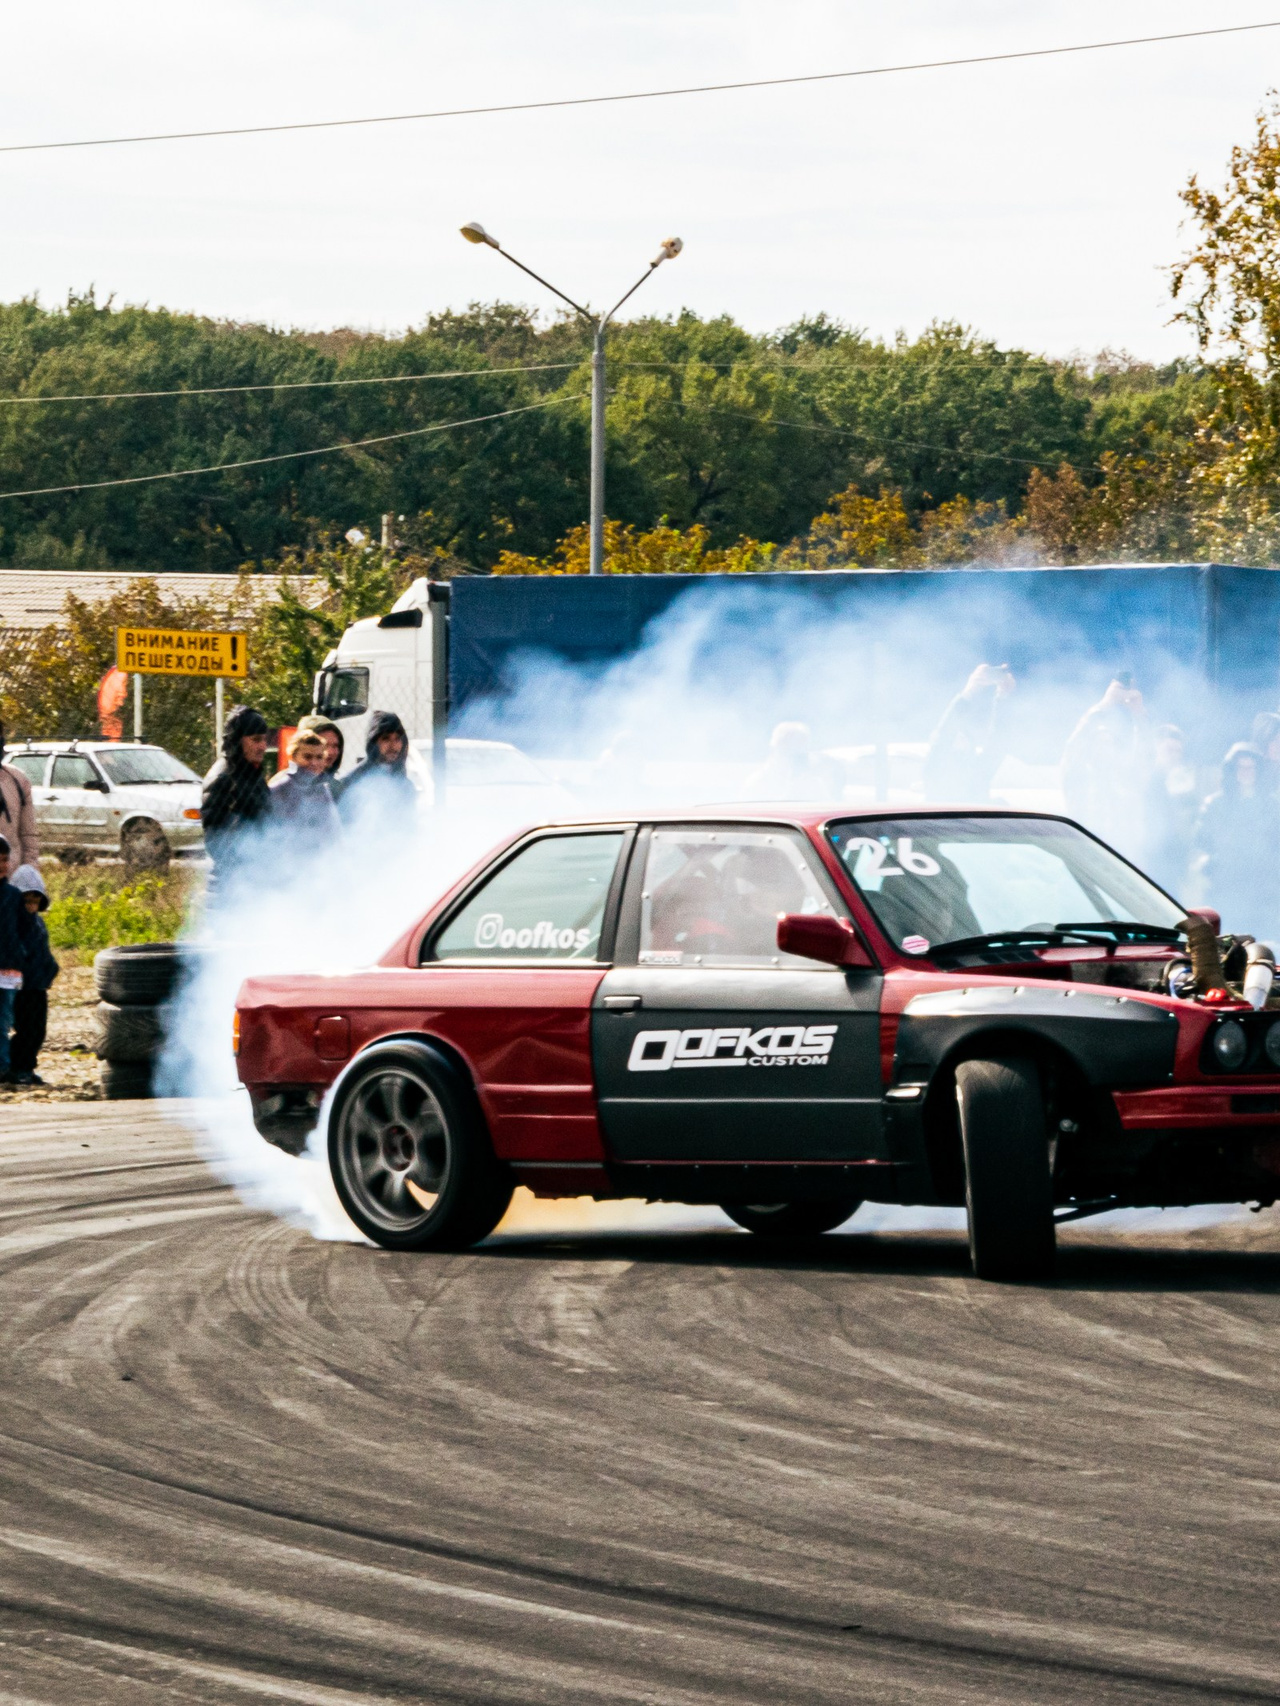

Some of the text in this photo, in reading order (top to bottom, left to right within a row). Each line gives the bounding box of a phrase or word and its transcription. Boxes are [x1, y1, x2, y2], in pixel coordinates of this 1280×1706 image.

[125, 632, 219, 651] ВНИМАНИЕ
[125, 651, 223, 671] ПЕШЕХОДЫ
[846, 837, 941, 876] 26
[500, 921, 590, 949] oofkos
[628, 1025, 838, 1071] OOFKOS
[748, 1055, 829, 1066] CUSTOM
